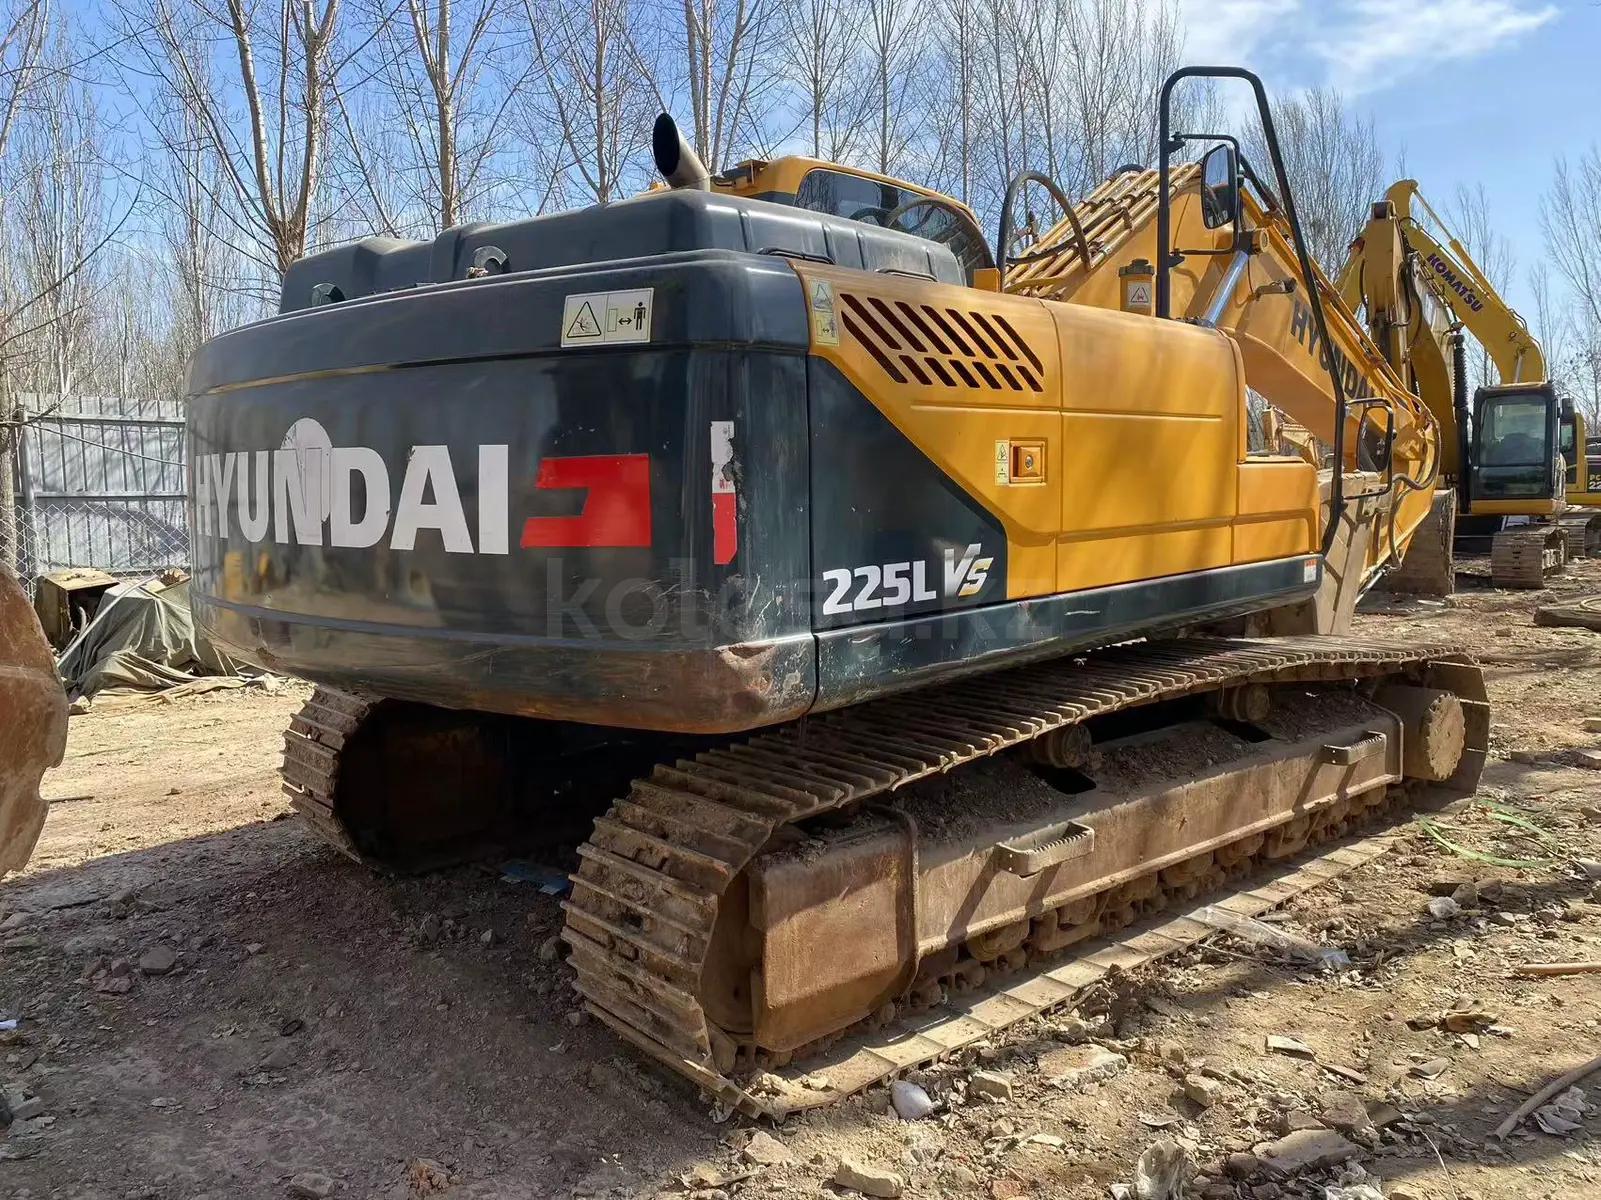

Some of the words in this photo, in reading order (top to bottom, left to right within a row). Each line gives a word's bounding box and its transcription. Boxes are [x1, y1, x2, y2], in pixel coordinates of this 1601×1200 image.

[1426, 252, 1483, 312] KOMATSU
[195, 444, 509, 554] HYUNDAI
[822, 559, 937, 616] 225L
